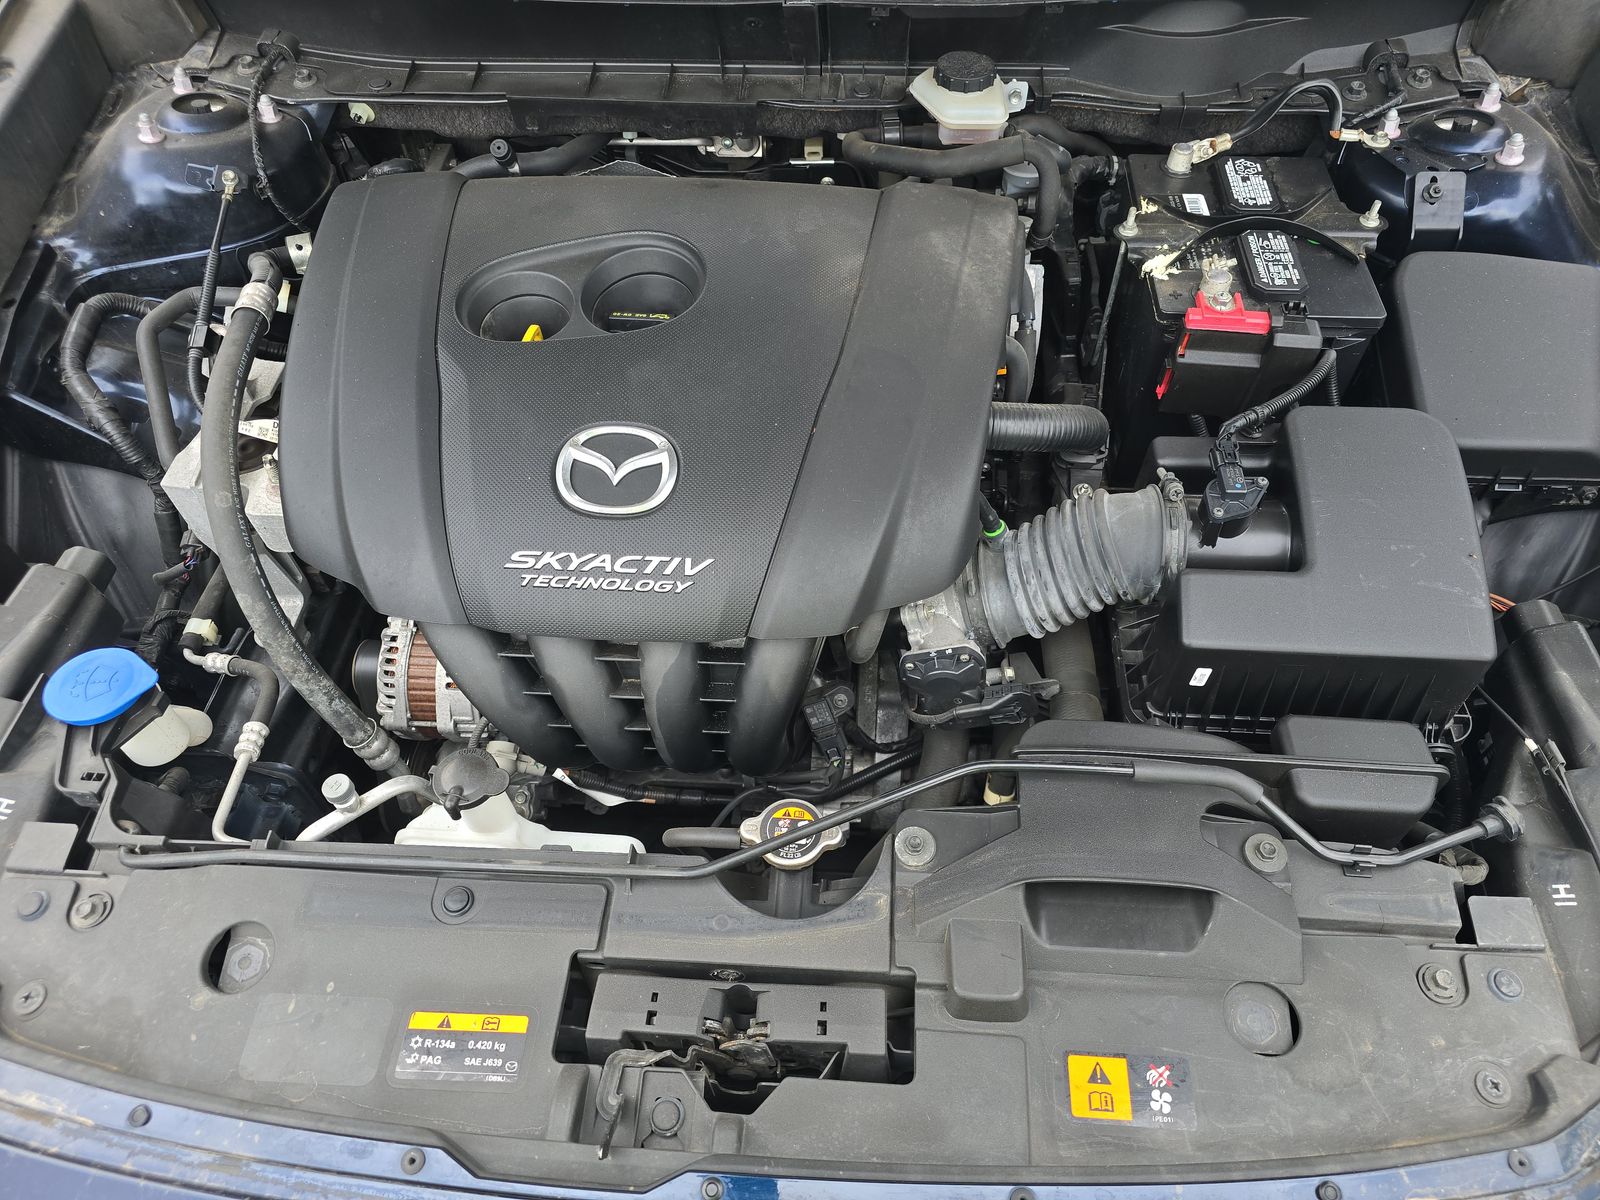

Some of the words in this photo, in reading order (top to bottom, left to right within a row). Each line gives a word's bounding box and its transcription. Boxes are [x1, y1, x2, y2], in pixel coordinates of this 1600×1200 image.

[1247, 235, 1259, 253] POISON
[236, 511, 252, 548] GALAXY
[503, 551, 715, 576] SKYACTIV
[520, 574, 695, 594] TECHNOLOGY
[424, 1039, 456, 1049] R-134a
[468, 1040, 493, 1050] 0.420
[494, 1041, 506, 1052] kg
[420, 1055, 442, 1065] PAG
[464, 1058, 482, 1066] SAE
[483, 1058, 503, 1067] J639
